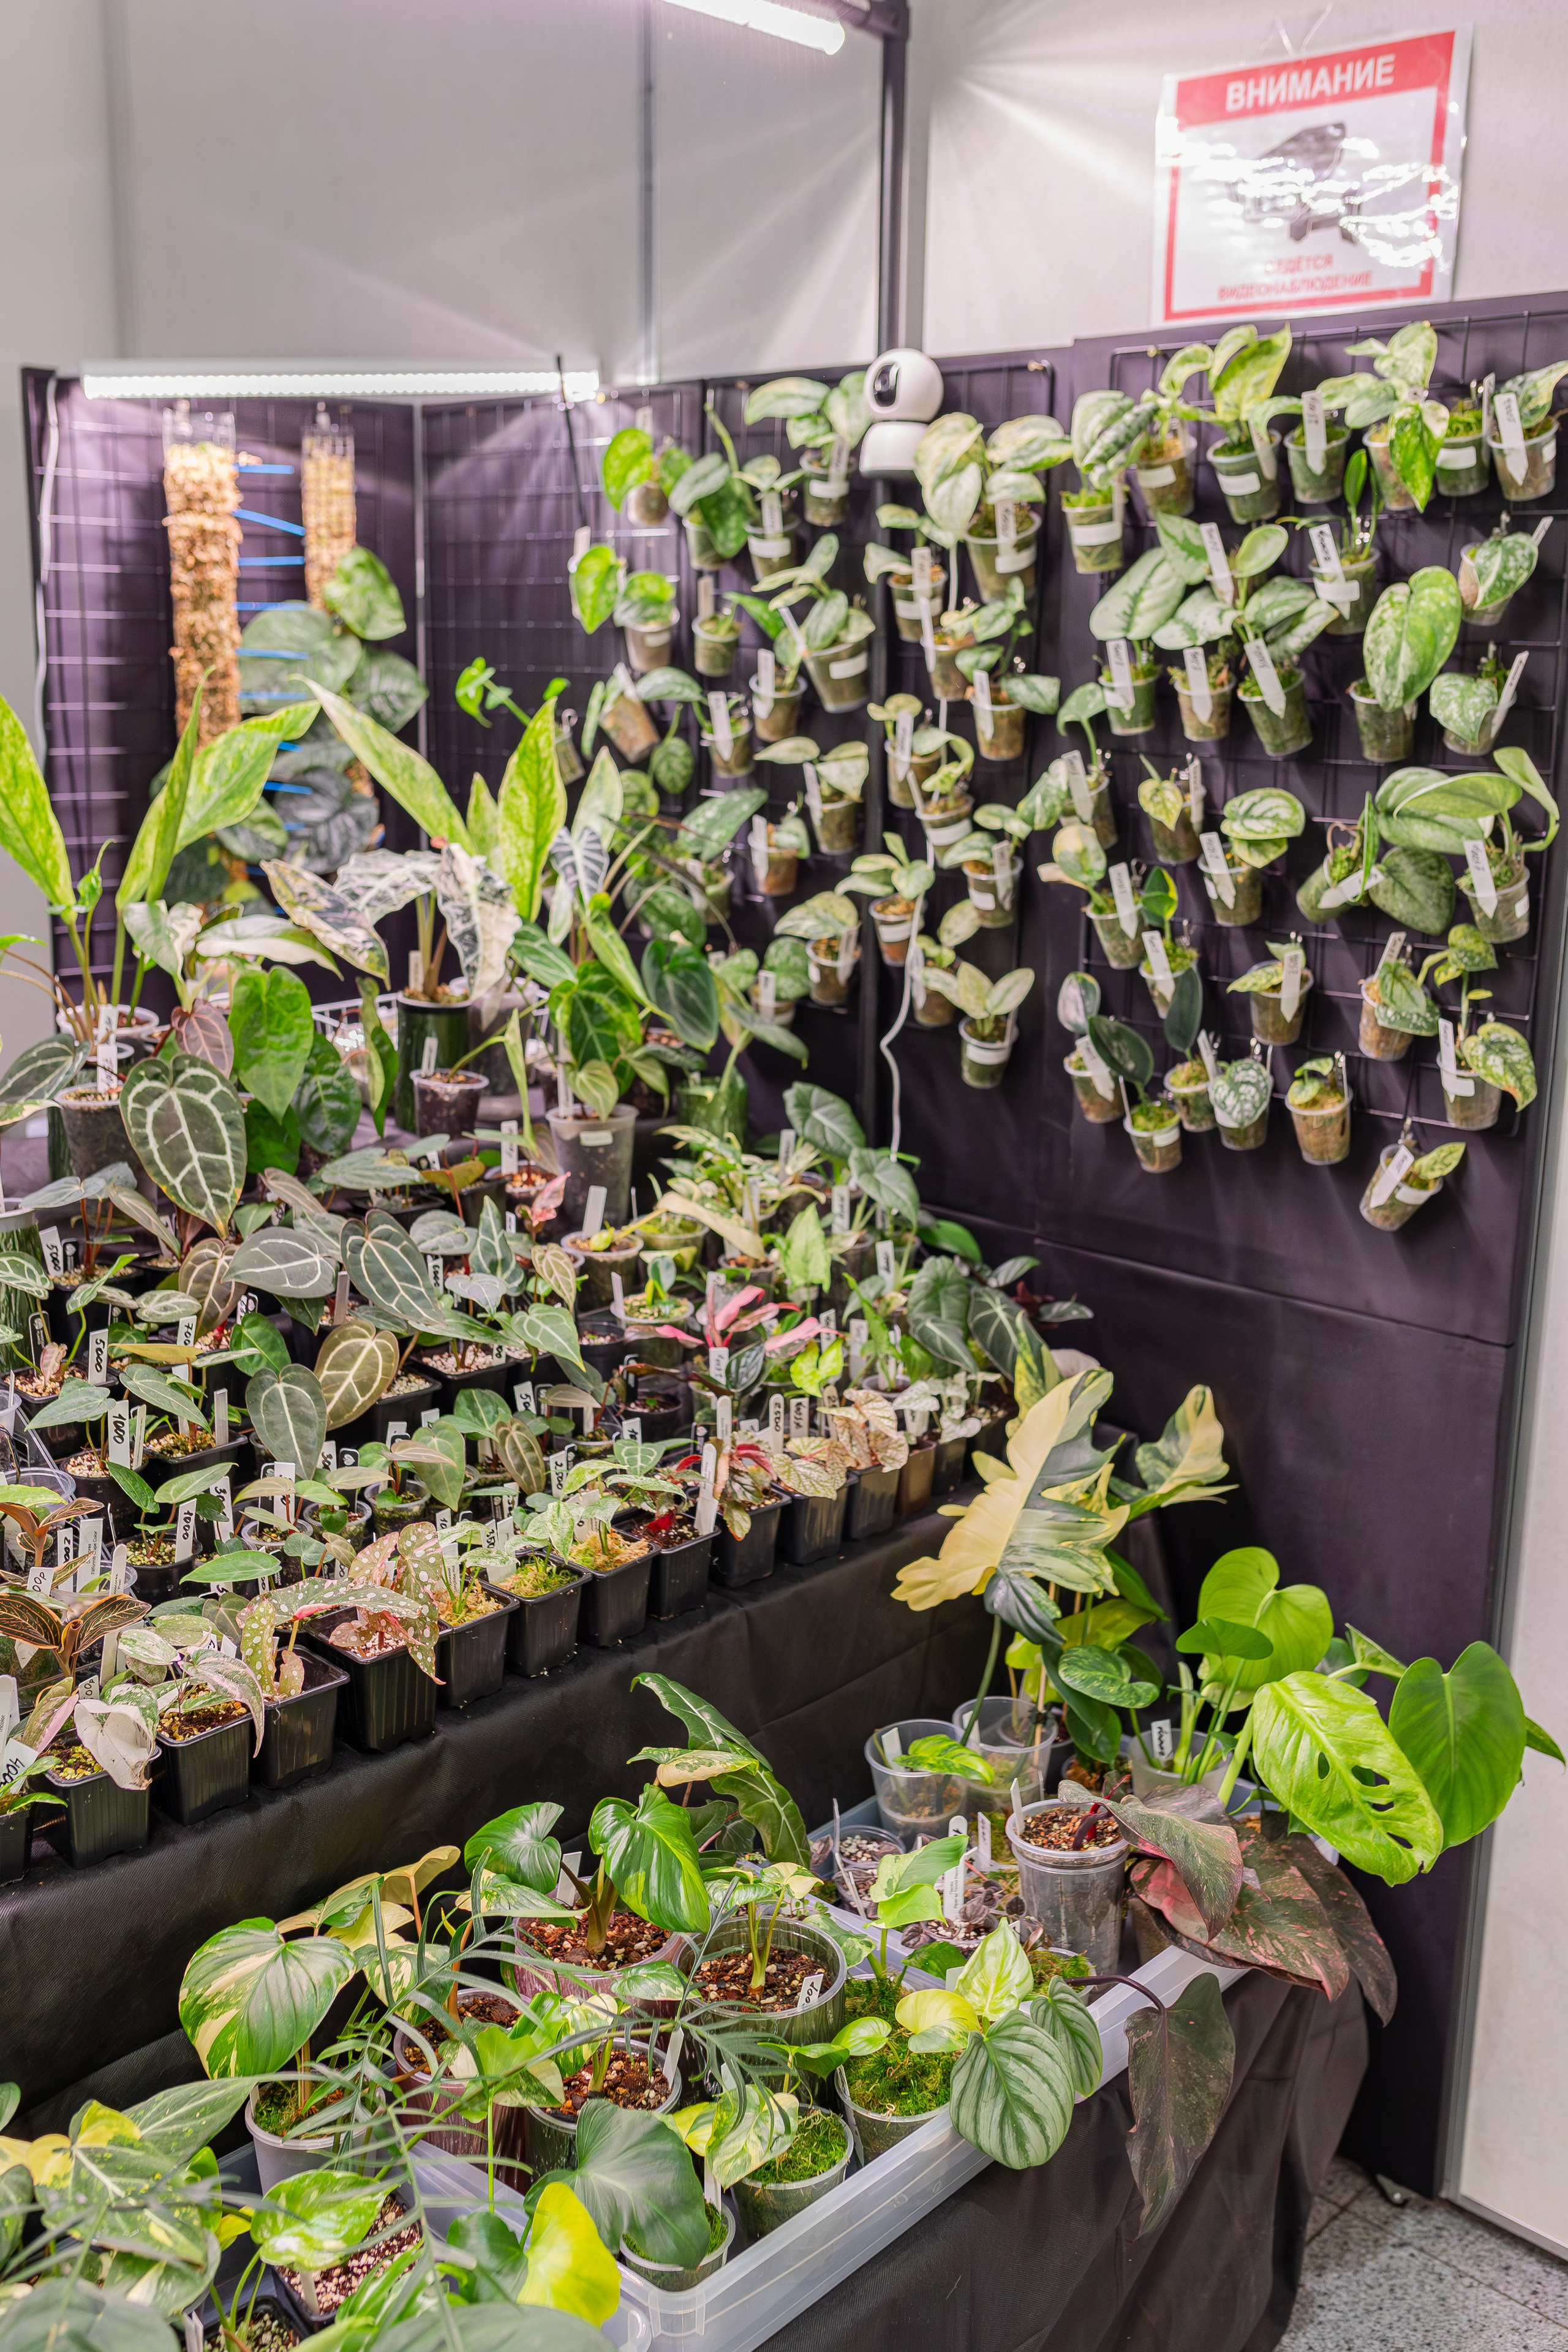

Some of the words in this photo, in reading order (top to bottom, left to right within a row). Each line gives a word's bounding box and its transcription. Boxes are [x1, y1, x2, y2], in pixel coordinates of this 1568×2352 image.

[1226, 54, 1395, 113] ВНИМАНИЕ
[1218, 270, 1373, 301] ВИДЕОНАБЛЮДЕНИЕ
[46, 1243, 61, 1272] 5000
[95, 1338, 105, 1373] 5000
[112, 1413, 127, 1445] 1000
[183, 1509, 194, 1540] 1000
